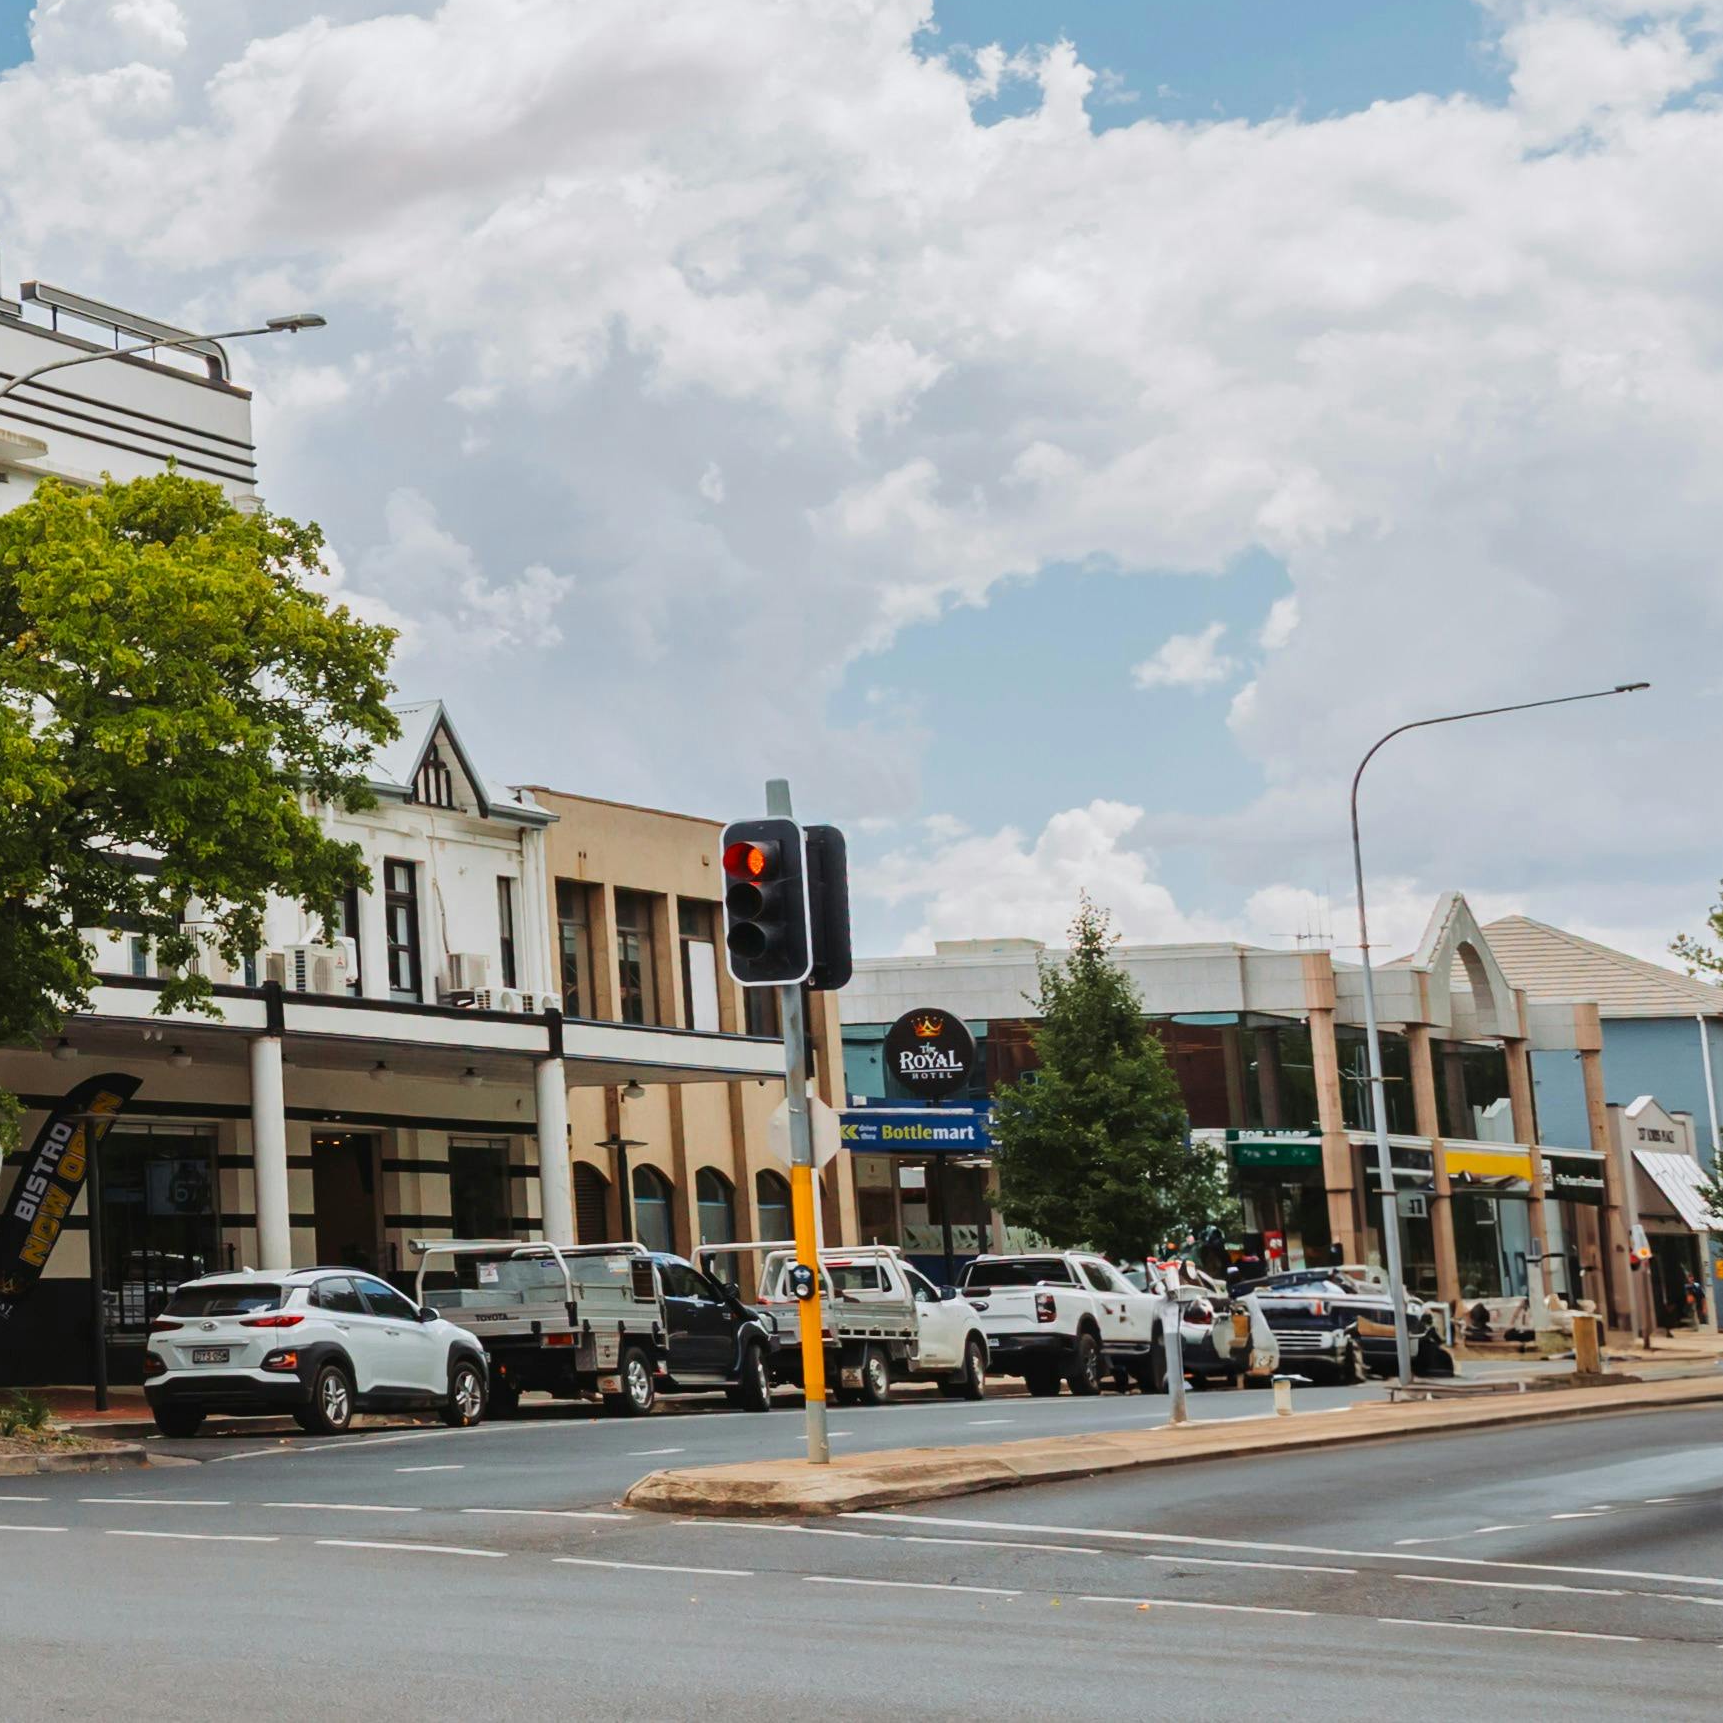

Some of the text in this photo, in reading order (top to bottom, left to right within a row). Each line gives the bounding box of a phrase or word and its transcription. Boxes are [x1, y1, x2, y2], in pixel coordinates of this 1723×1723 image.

[919, 1042, 936, 1053] The
[899, 1050, 962, 1070] ROYAL
[882, 1124, 975, 1140] Bottlemart
[14, 1121, 73, 1222] BISTRO
[19, 1091, 123, 1266] NOW OPN
[475, 1312, 508, 1322] TOYOTA
